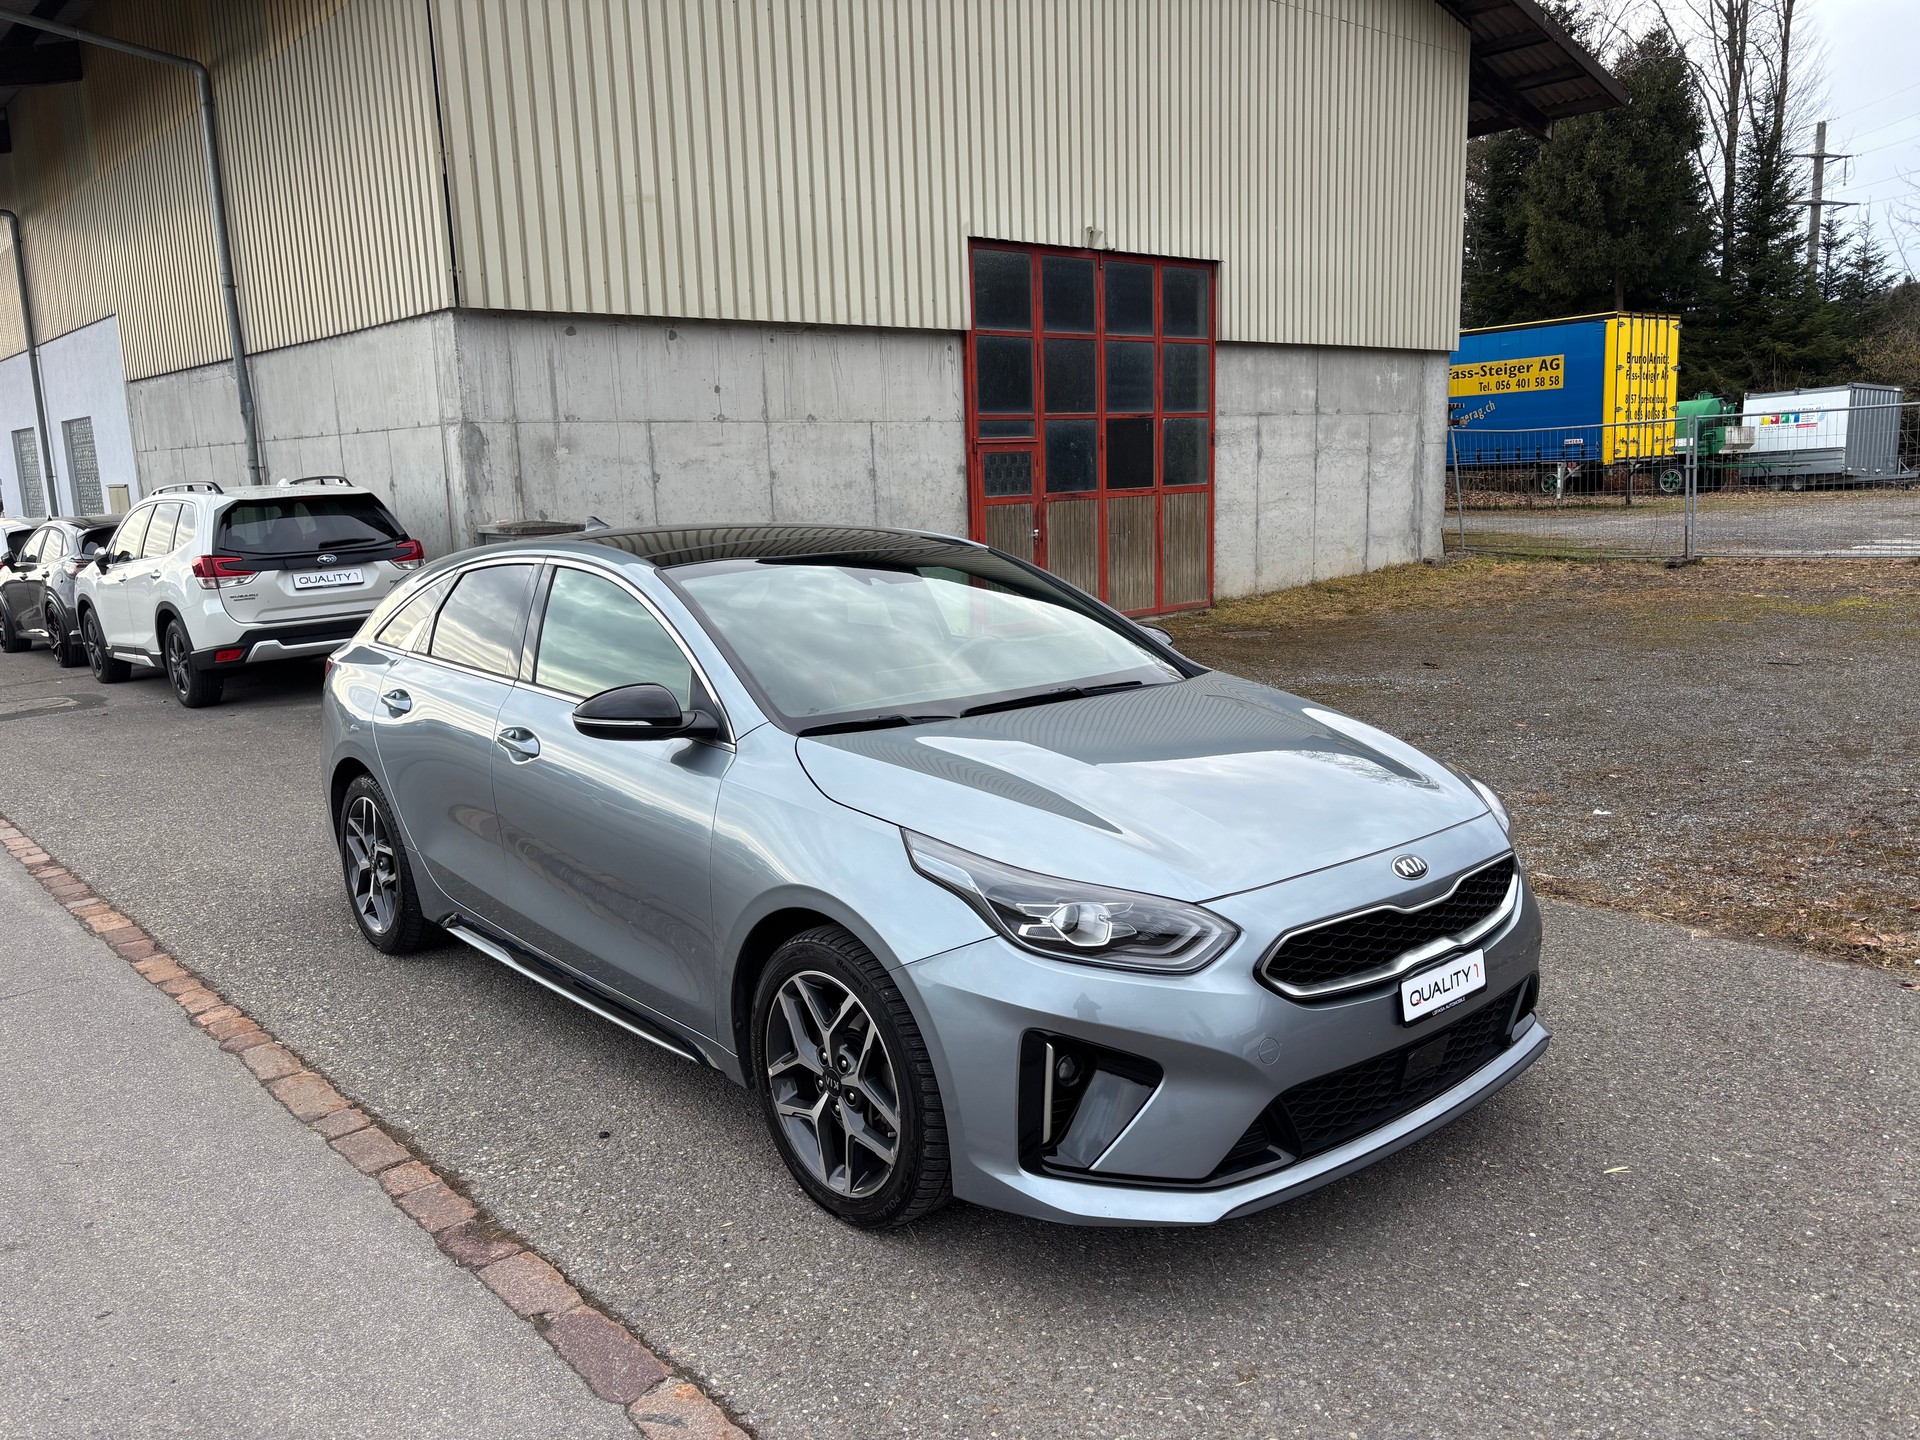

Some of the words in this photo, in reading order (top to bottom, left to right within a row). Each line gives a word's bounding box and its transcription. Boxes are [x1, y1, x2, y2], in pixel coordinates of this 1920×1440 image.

[1539, 358, 1560, 372] AG
[1479, 381, 1492, 392] Tel.
[1495, 380, 1511, 391] 056
[1516, 378, 1530, 389] 401
[1535, 376, 1545, 387] 58
[1549, 375, 1560, 386] 58
[299, 572, 351, 585] QUALITY
[354, 572, 359, 580] 1
[1396, 856, 1427, 876] KIA
[1409, 965, 1471, 1007] QUALITY
[1473, 963, 1480, 978] 1
[825, 1074, 840, 1091] KIA
